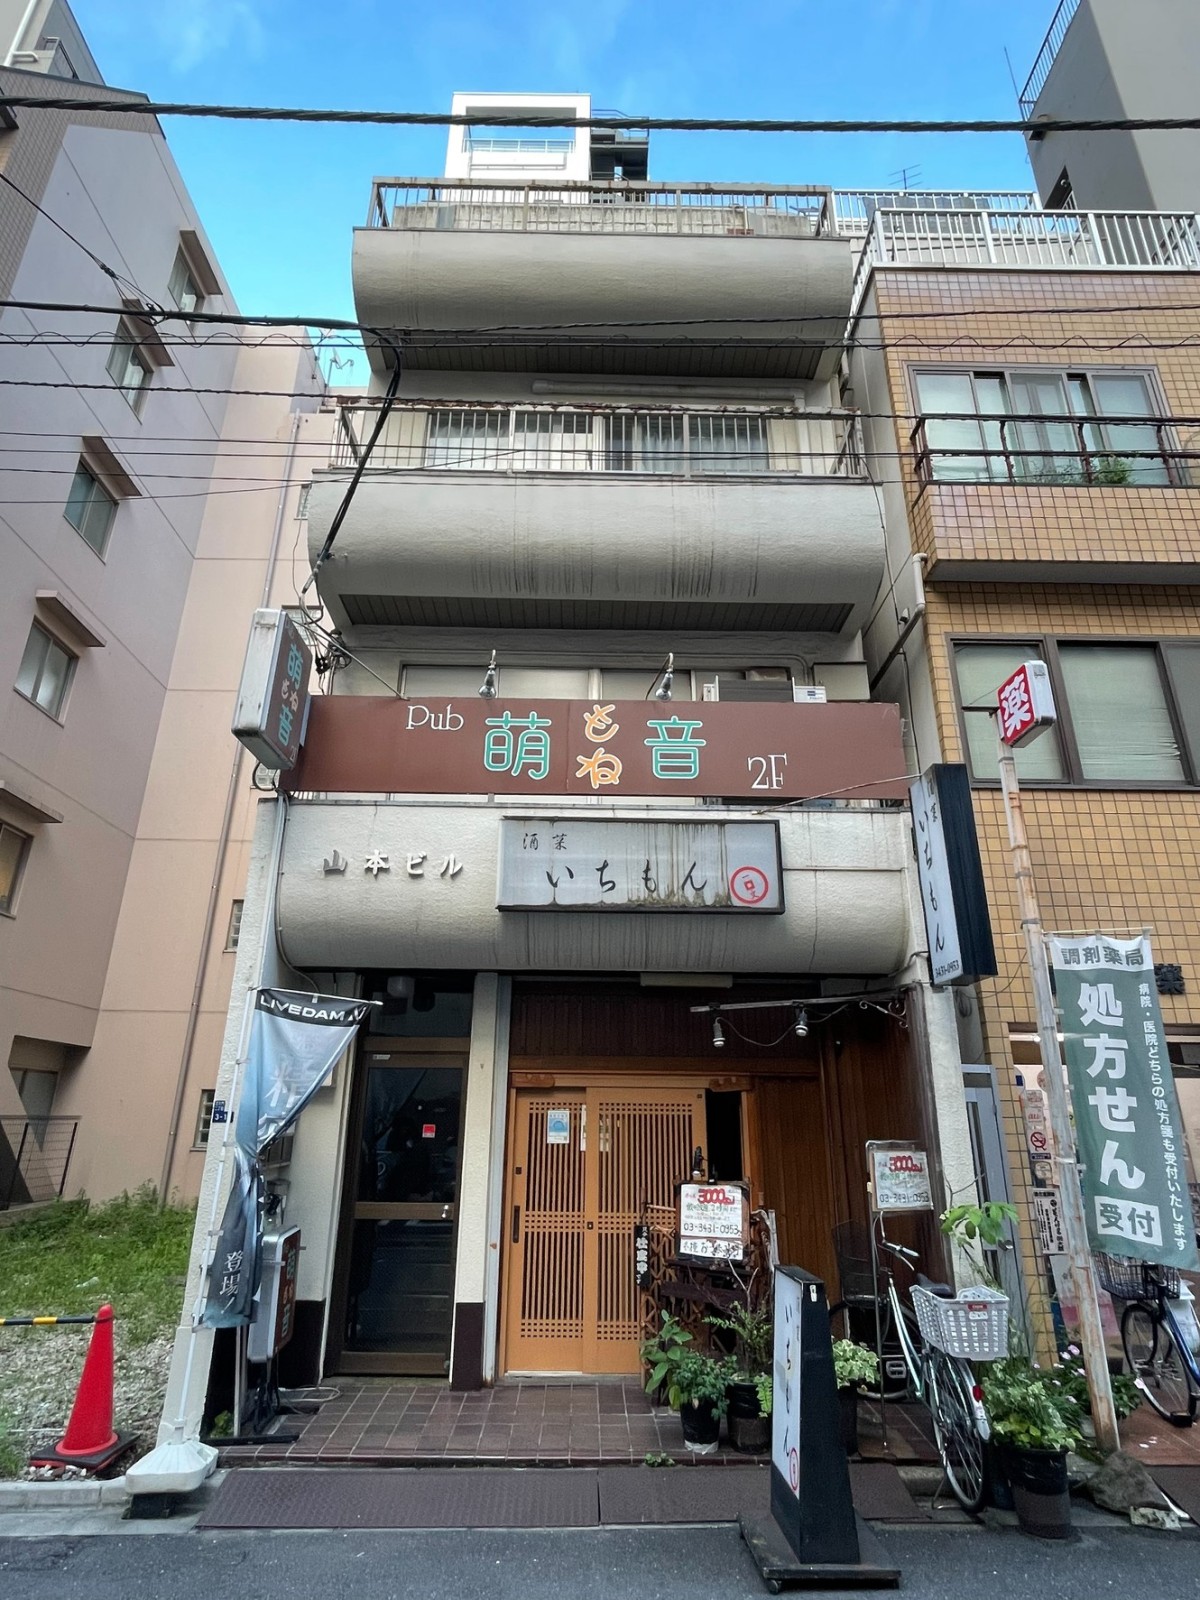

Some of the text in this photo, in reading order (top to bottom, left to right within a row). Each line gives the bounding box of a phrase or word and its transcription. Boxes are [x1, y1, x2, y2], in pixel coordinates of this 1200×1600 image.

[405, 704, 464, 732] Pub
[1001, 672, 1033, 737] 薬
[483, 703, 707, 790] 萌 もね 音
[746, 753, 788, 791] 2F
[321, 849, 464, 878] 山本ビル
[545, 860, 708, 894] いちもん
[1061, 946, 1144, 966] 調剤薬局
[260, 995, 345, 1021] LIVEDAM
[1077, 982, 1147, 1190] 処方せん
[1101, 1203, 1155, 1239] 受付
